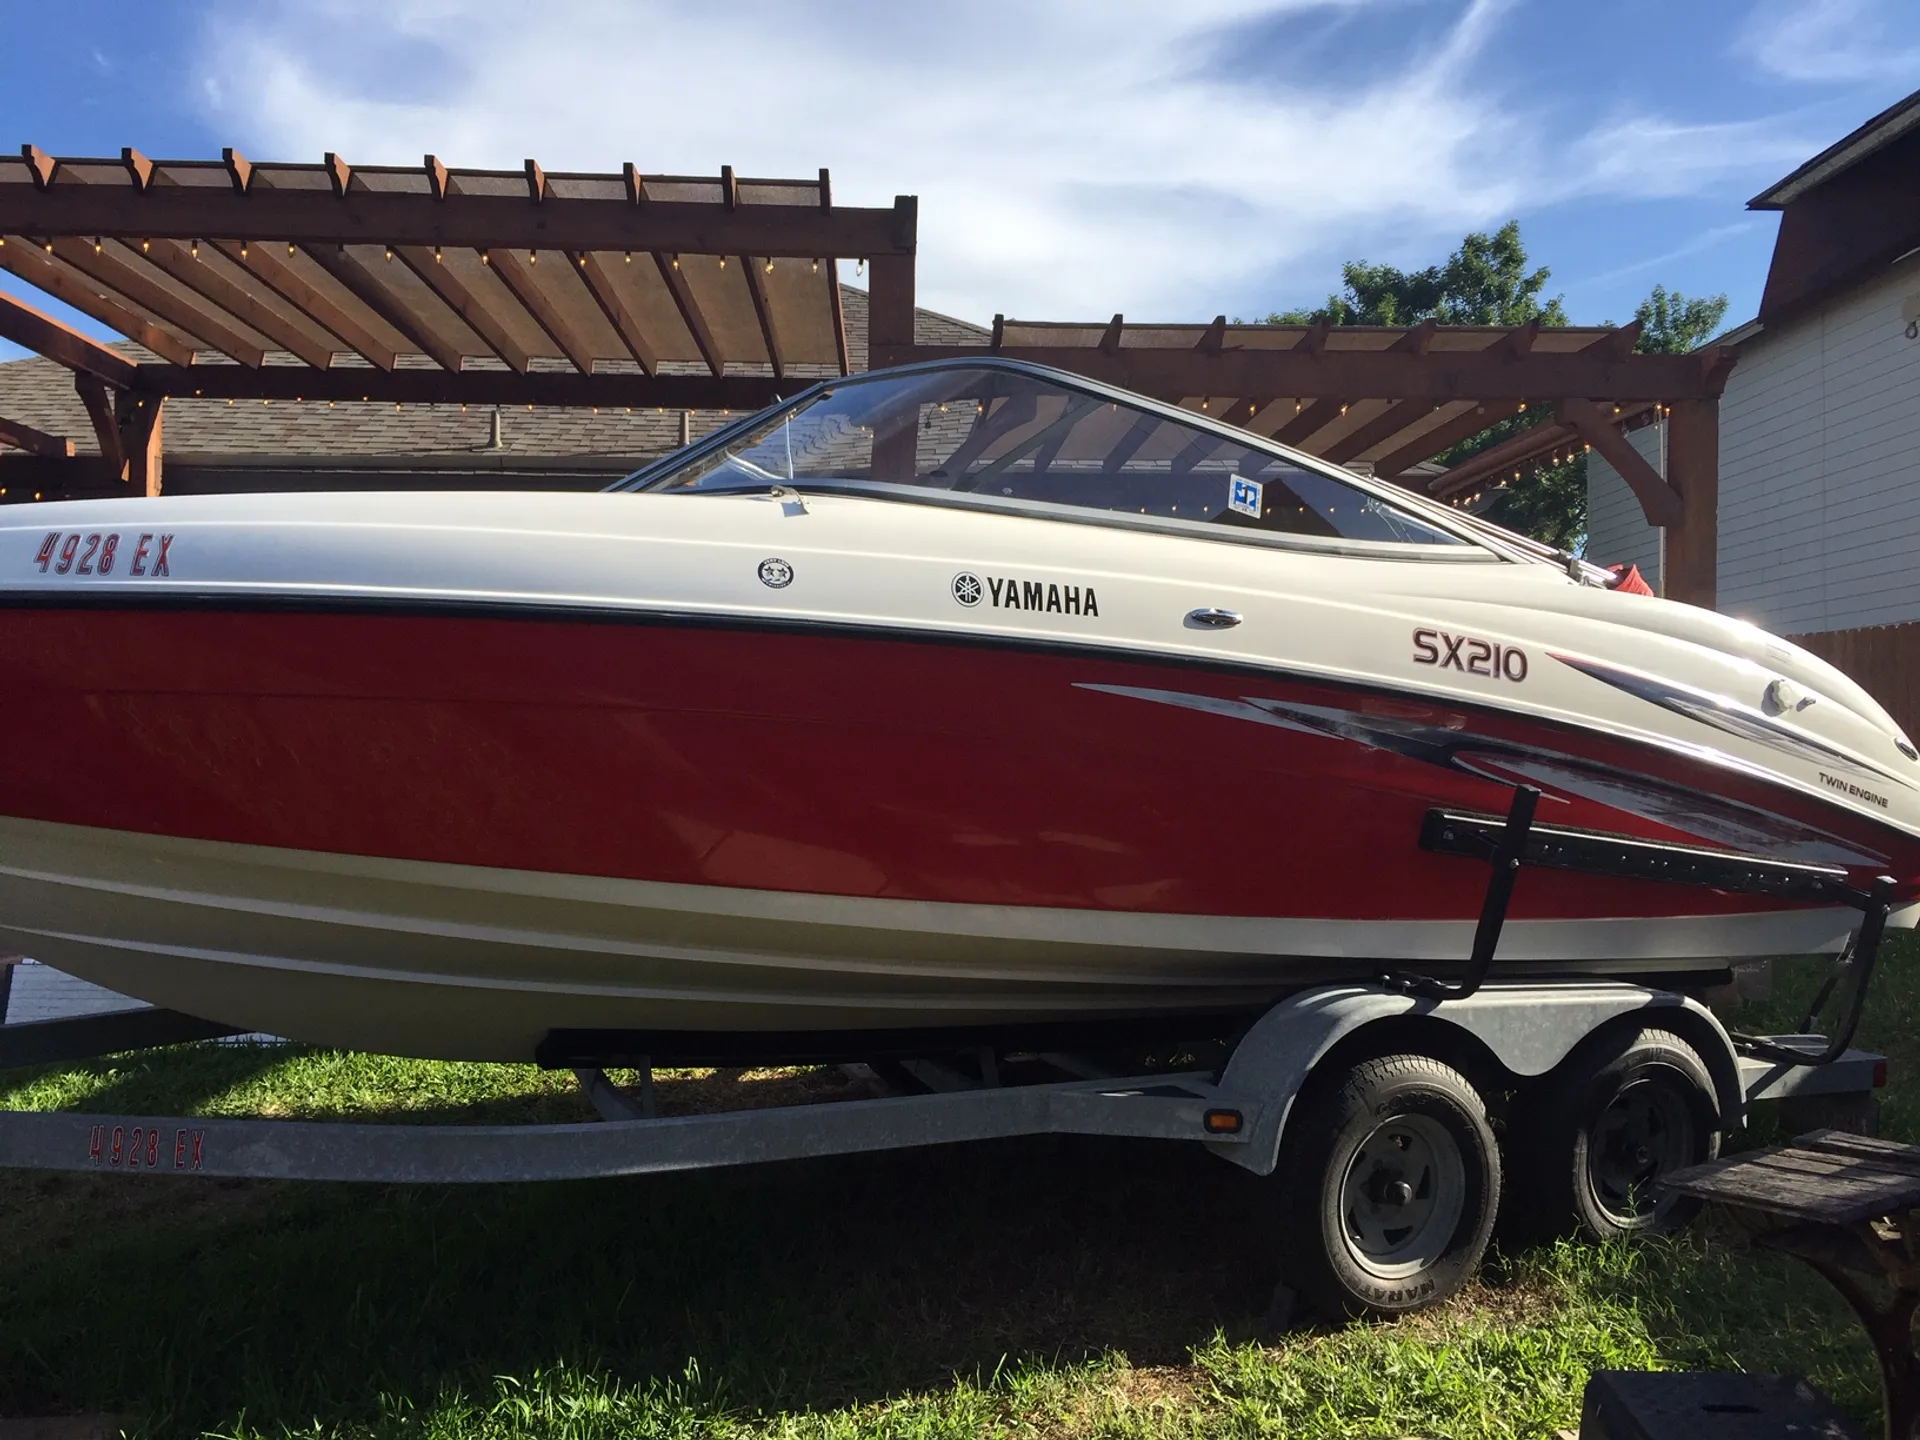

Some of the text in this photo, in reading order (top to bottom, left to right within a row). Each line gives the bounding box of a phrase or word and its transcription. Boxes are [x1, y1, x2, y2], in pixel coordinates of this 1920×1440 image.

[33, 532, 174, 577] 4928 EX
[987, 576, 1098, 617] YAMAHA
[1412, 627, 1528, 683] SX210
[1819, 772, 1889, 808] TWIN ENGINE
[89, 1125, 205, 1170] 4928 EX
